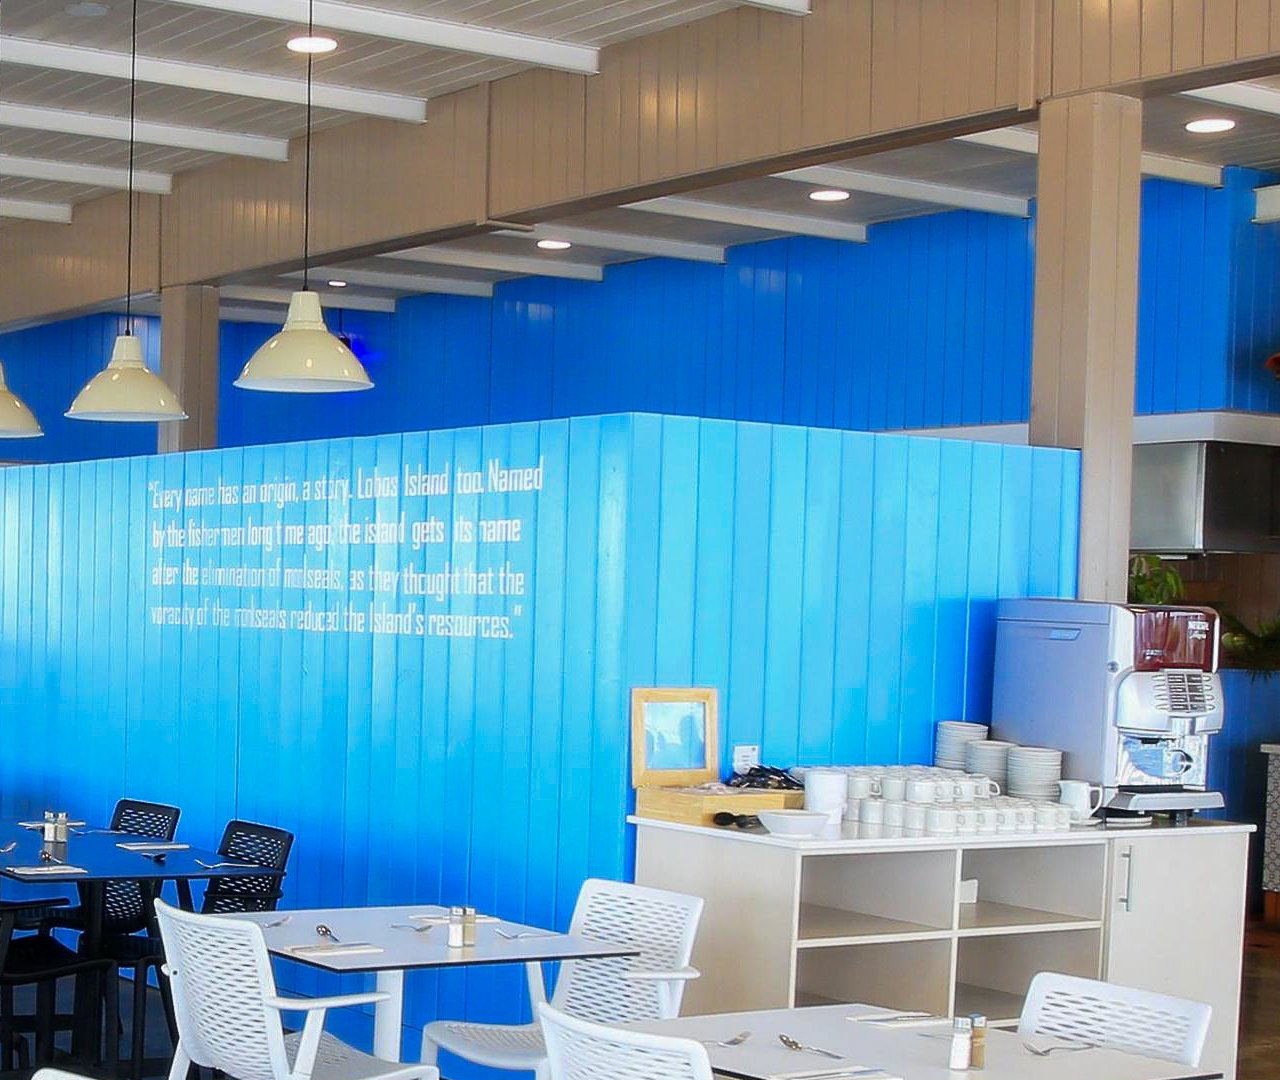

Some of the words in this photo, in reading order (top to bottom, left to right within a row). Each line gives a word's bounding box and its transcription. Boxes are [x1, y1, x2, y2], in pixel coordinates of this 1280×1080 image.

[185, 485, 215, 507] name
[218, 477, 239, 505] has
[242, 484, 257, 504] an
[259, 476, 299, 509] origin,
[302, 480, 311, 501] a
[357, 466, 398, 499] Lobos
[404, 461, 449, 497] Island
[488, 455, 545, 494] Named
[152, 519, 165, 551] by
[166, 519, 186, 547] the
[248, 516, 272, 551] long
[275, 520, 304, 545] tme
[339, 513, 361, 545] the
[364, 511, 406, 544] island
[411, 515, 445, 550] gets
[479, 518, 522, 543] name
[152, 558, 178, 586] after
[182, 558, 199, 586] the
[268, 557, 282, 588] of
[349, 569, 364, 591] as
[368, 564, 400, 600] they
[403, 561, 460, 602] thought
[463, 561, 494, 596] that
[499, 561, 525, 596] the
[197, 597, 210, 626] of
[213, 598, 230, 627] the
[291, 599, 340, 632] reduced
[343, 600, 365, 633] the
[369, 601, 425, 636] Island's
